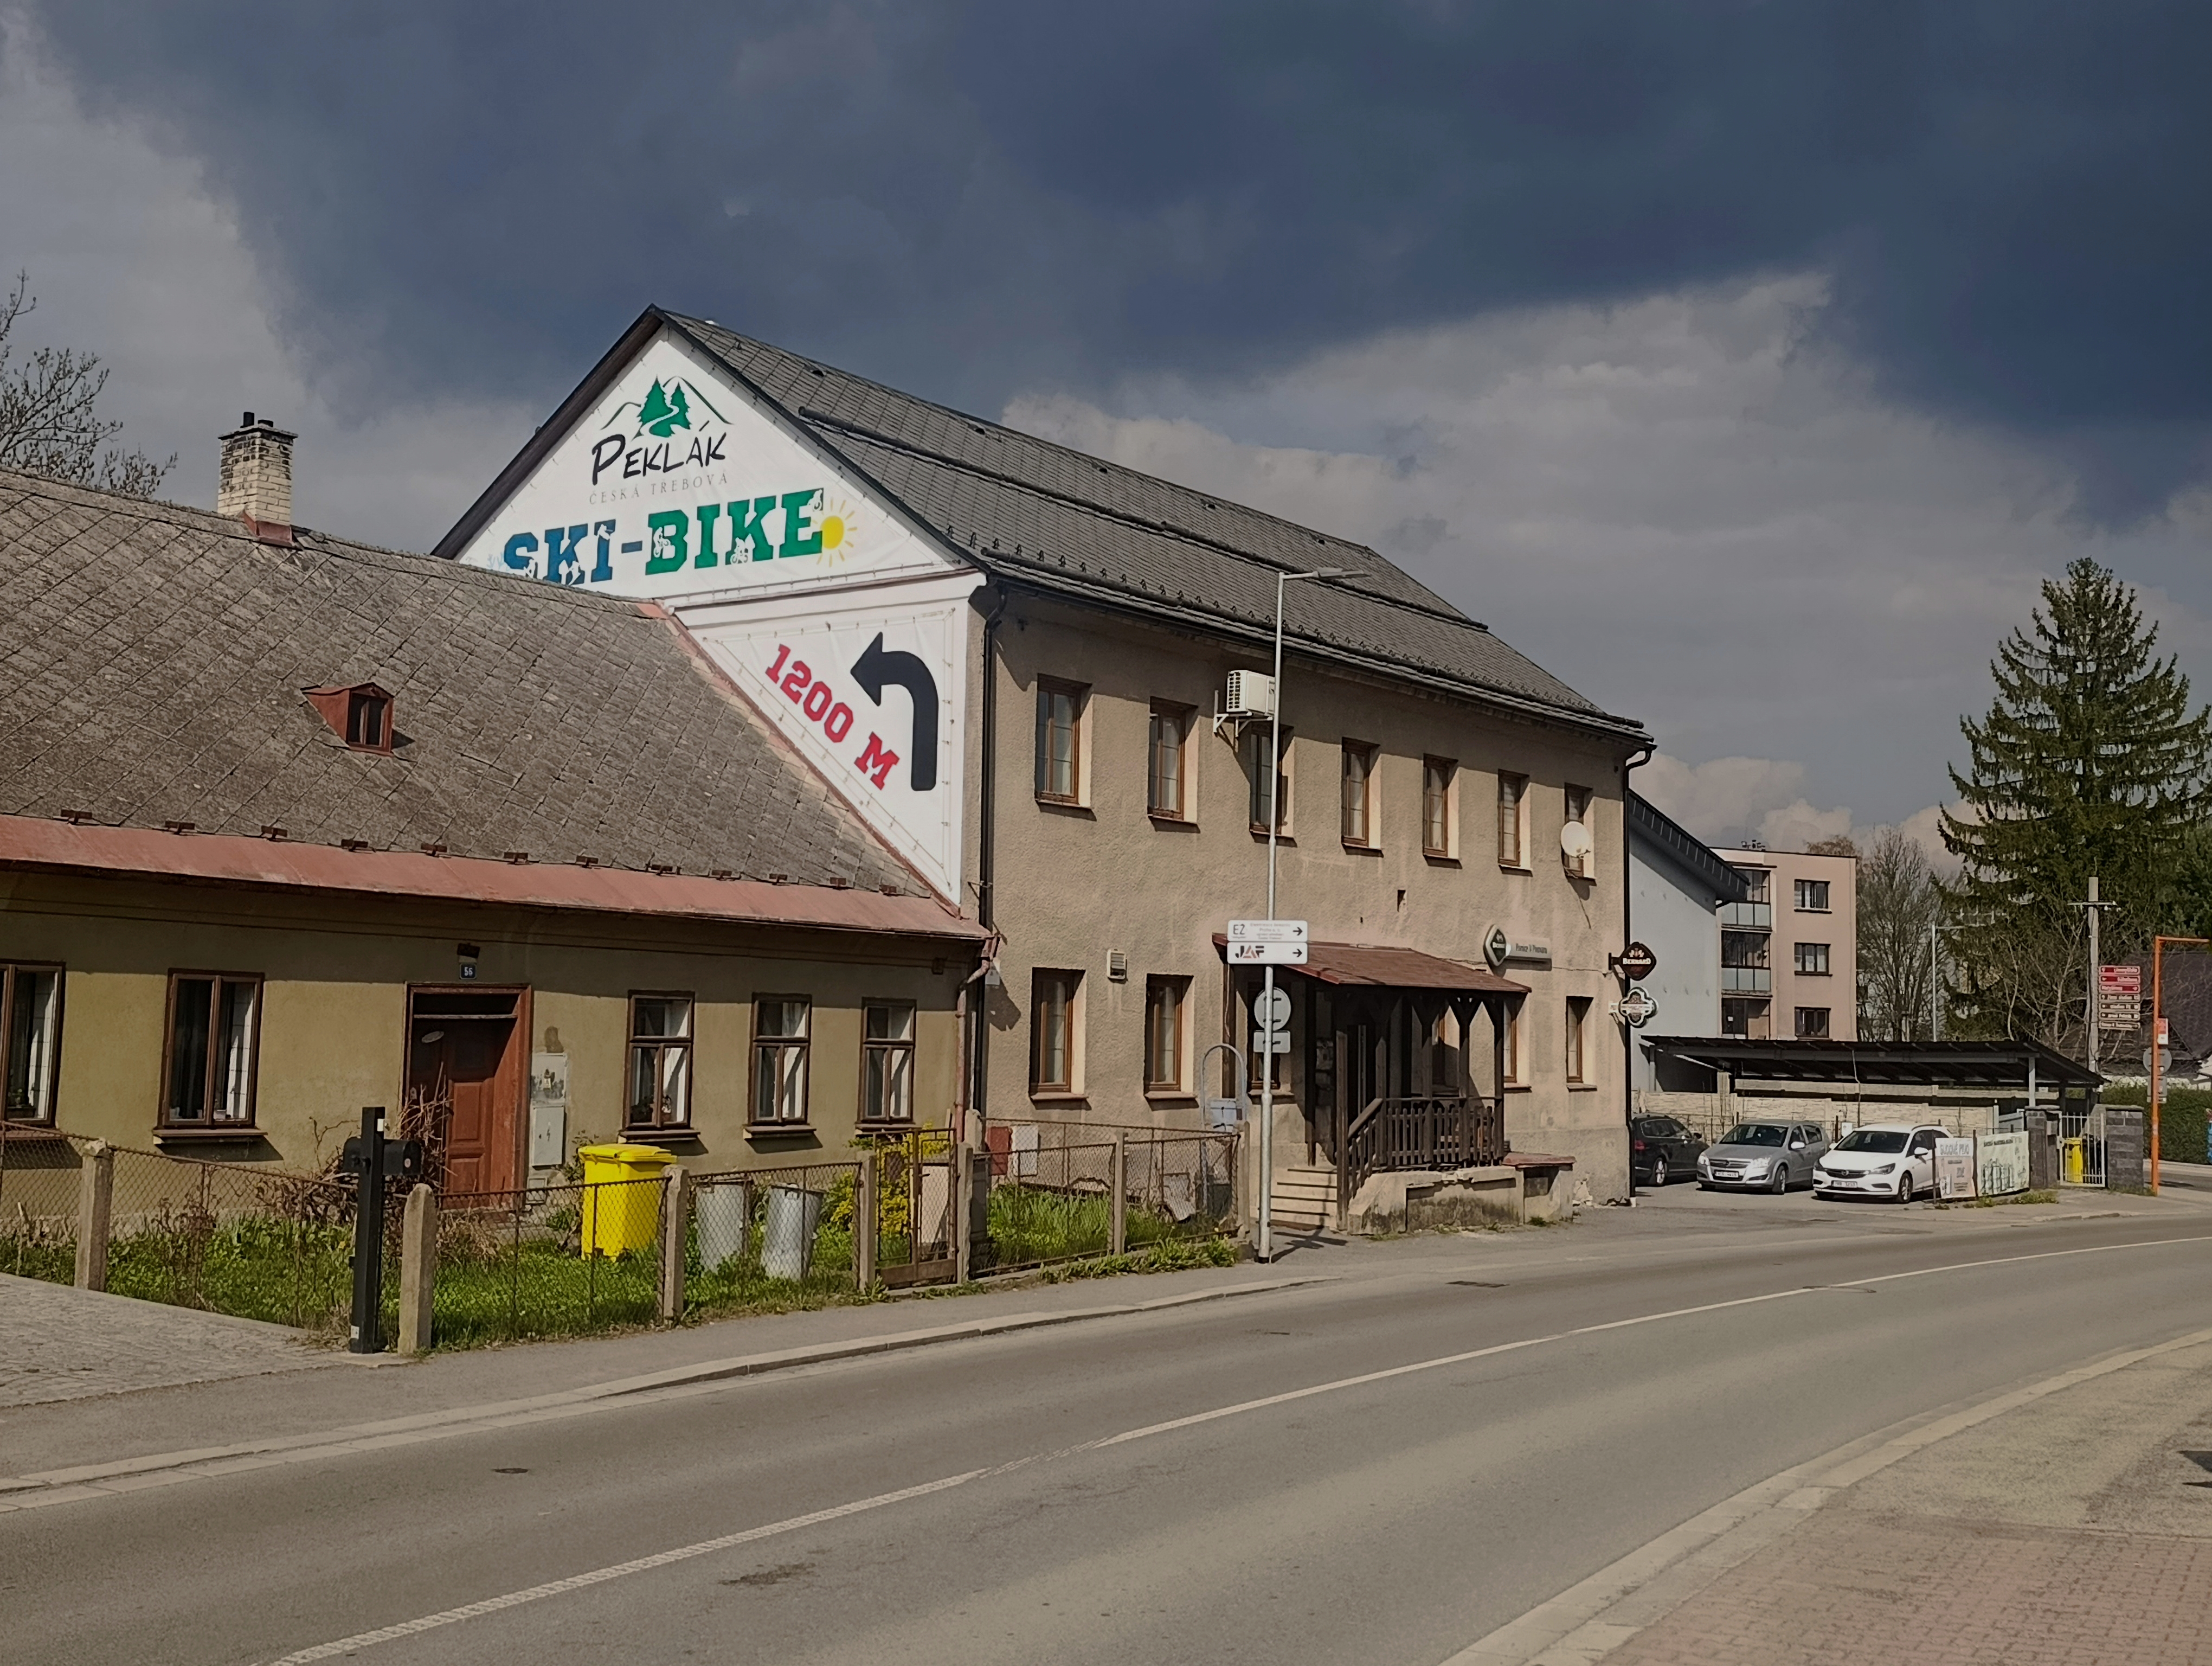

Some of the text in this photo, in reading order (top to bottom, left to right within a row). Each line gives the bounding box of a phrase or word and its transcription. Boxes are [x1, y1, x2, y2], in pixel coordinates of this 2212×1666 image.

[591, 420, 726, 485] PEKLÁK
[589, 470, 728, 505] ČESKÁ TŘEBOVÁ
[503, 488, 824, 586] SKI-BIKE
[765, 644, 900, 790] 1200 M
[1235, 945, 1264, 959] JAF
